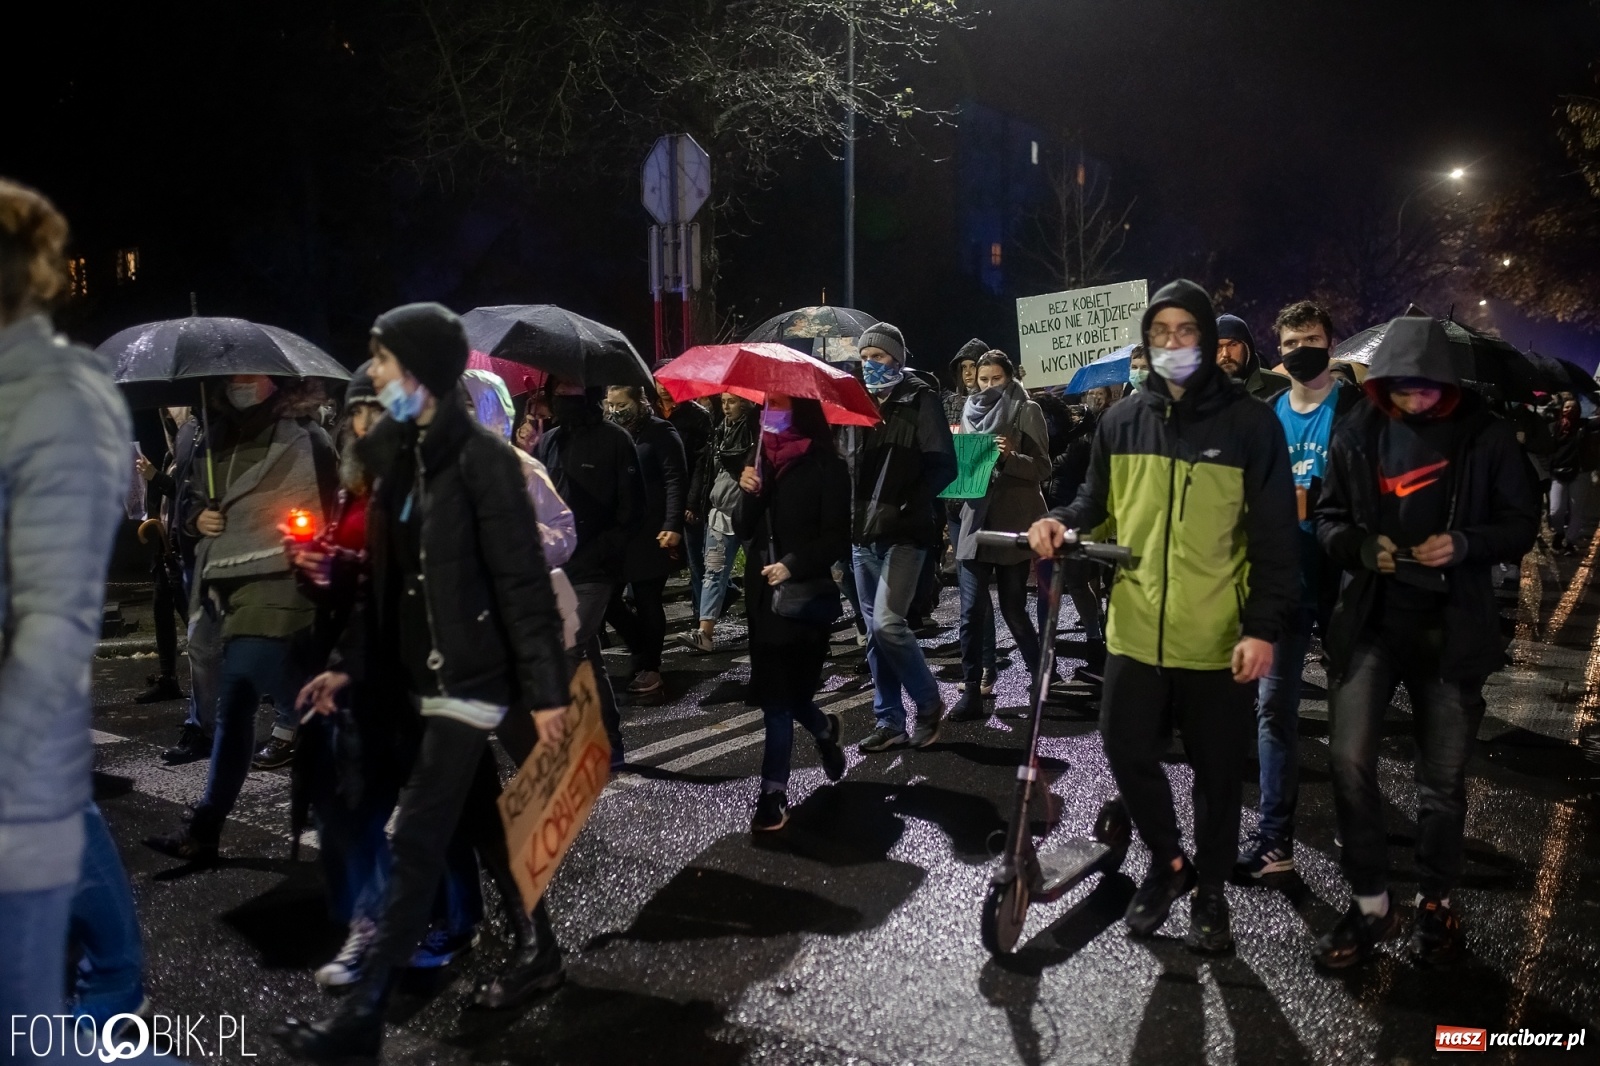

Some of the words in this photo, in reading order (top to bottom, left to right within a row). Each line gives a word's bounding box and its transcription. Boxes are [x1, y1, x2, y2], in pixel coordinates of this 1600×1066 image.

[1048, 301, 1068, 315] BEZ
[1072, 291, 1112, 311] KOBIET
[1021, 317, 1061, 335] DALEKO
[1065, 313, 1082, 329] NIE
[1051, 334, 1073, 350] BEZ
[1076, 326, 1119, 345] KOBIET
[1291, 458, 1315, 476] 4F
